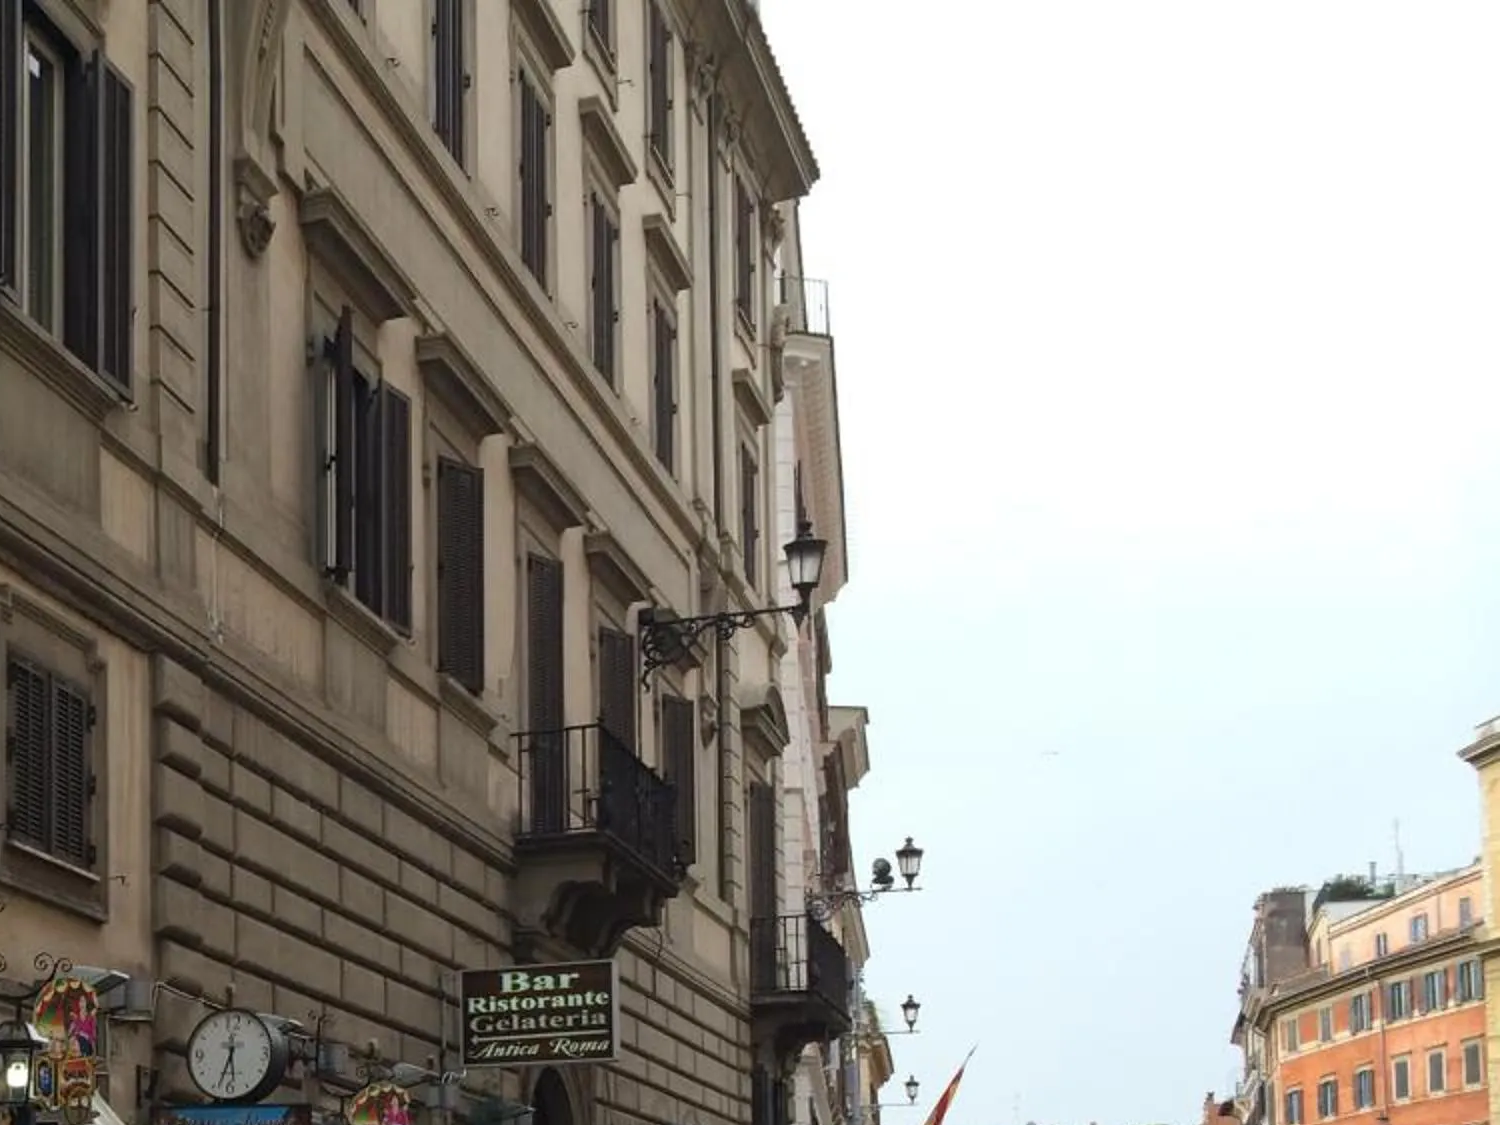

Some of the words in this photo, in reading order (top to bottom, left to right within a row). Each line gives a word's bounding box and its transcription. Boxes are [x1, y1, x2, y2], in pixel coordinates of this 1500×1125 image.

[500, 970, 580, 993] Bar
[467, 990, 609, 1014] Ristorante
[469, 1009, 607, 1033] Gelateria
[468, 1041, 540, 1059] Antica
[549, 1037, 610, 1057] Roma
